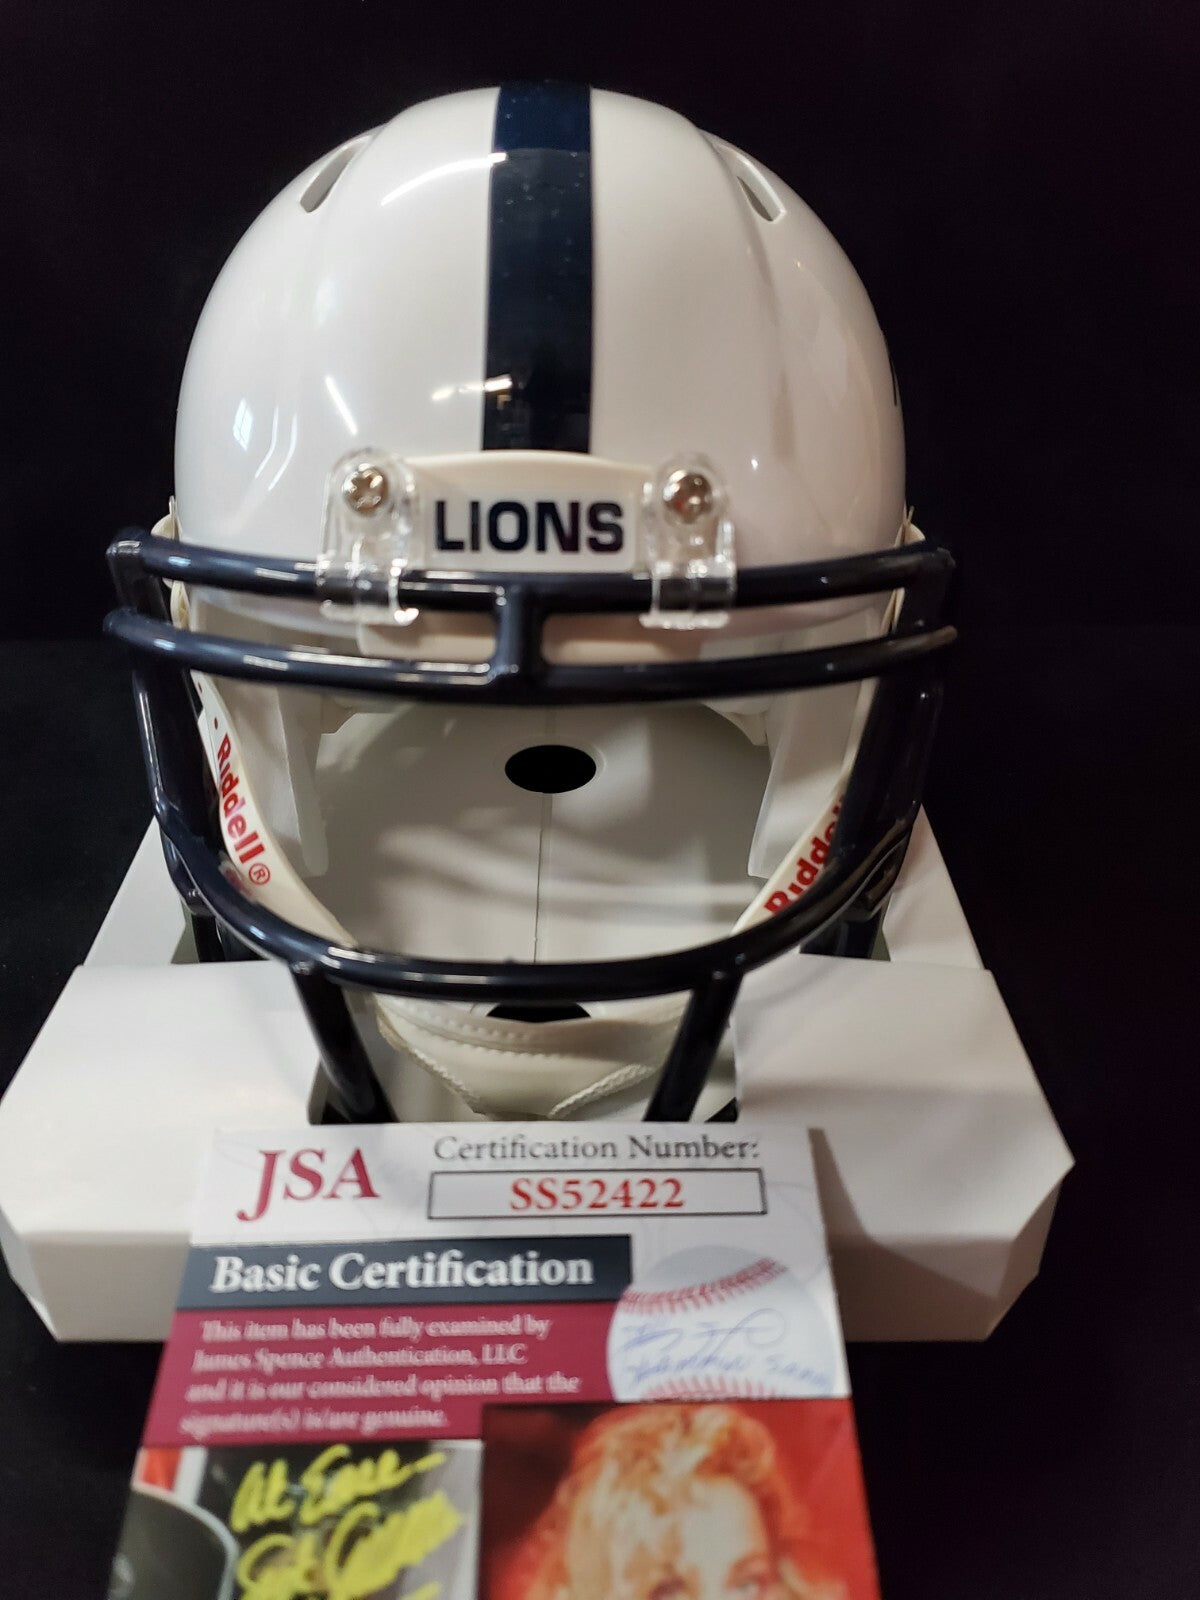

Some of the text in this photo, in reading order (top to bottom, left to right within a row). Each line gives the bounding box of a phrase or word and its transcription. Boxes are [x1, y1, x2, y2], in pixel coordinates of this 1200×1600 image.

[435, 501, 623, 553] LIONS
[433, 1134, 760, 1161] Certification Number:
[236, 1147, 380, 1222] JSA
[510, 1177, 685, 1212] SS52422
[210, 1250, 594, 1293] Basic Certification
[202, 1314, 552, 1343] This item has been fully examined by
[481, 1343, 528, 1365] LLC
[419, 1375, 499, 1402] opinion
[502, 1372, 544, 1395] that
[545, 1371, 581, 1394] the
